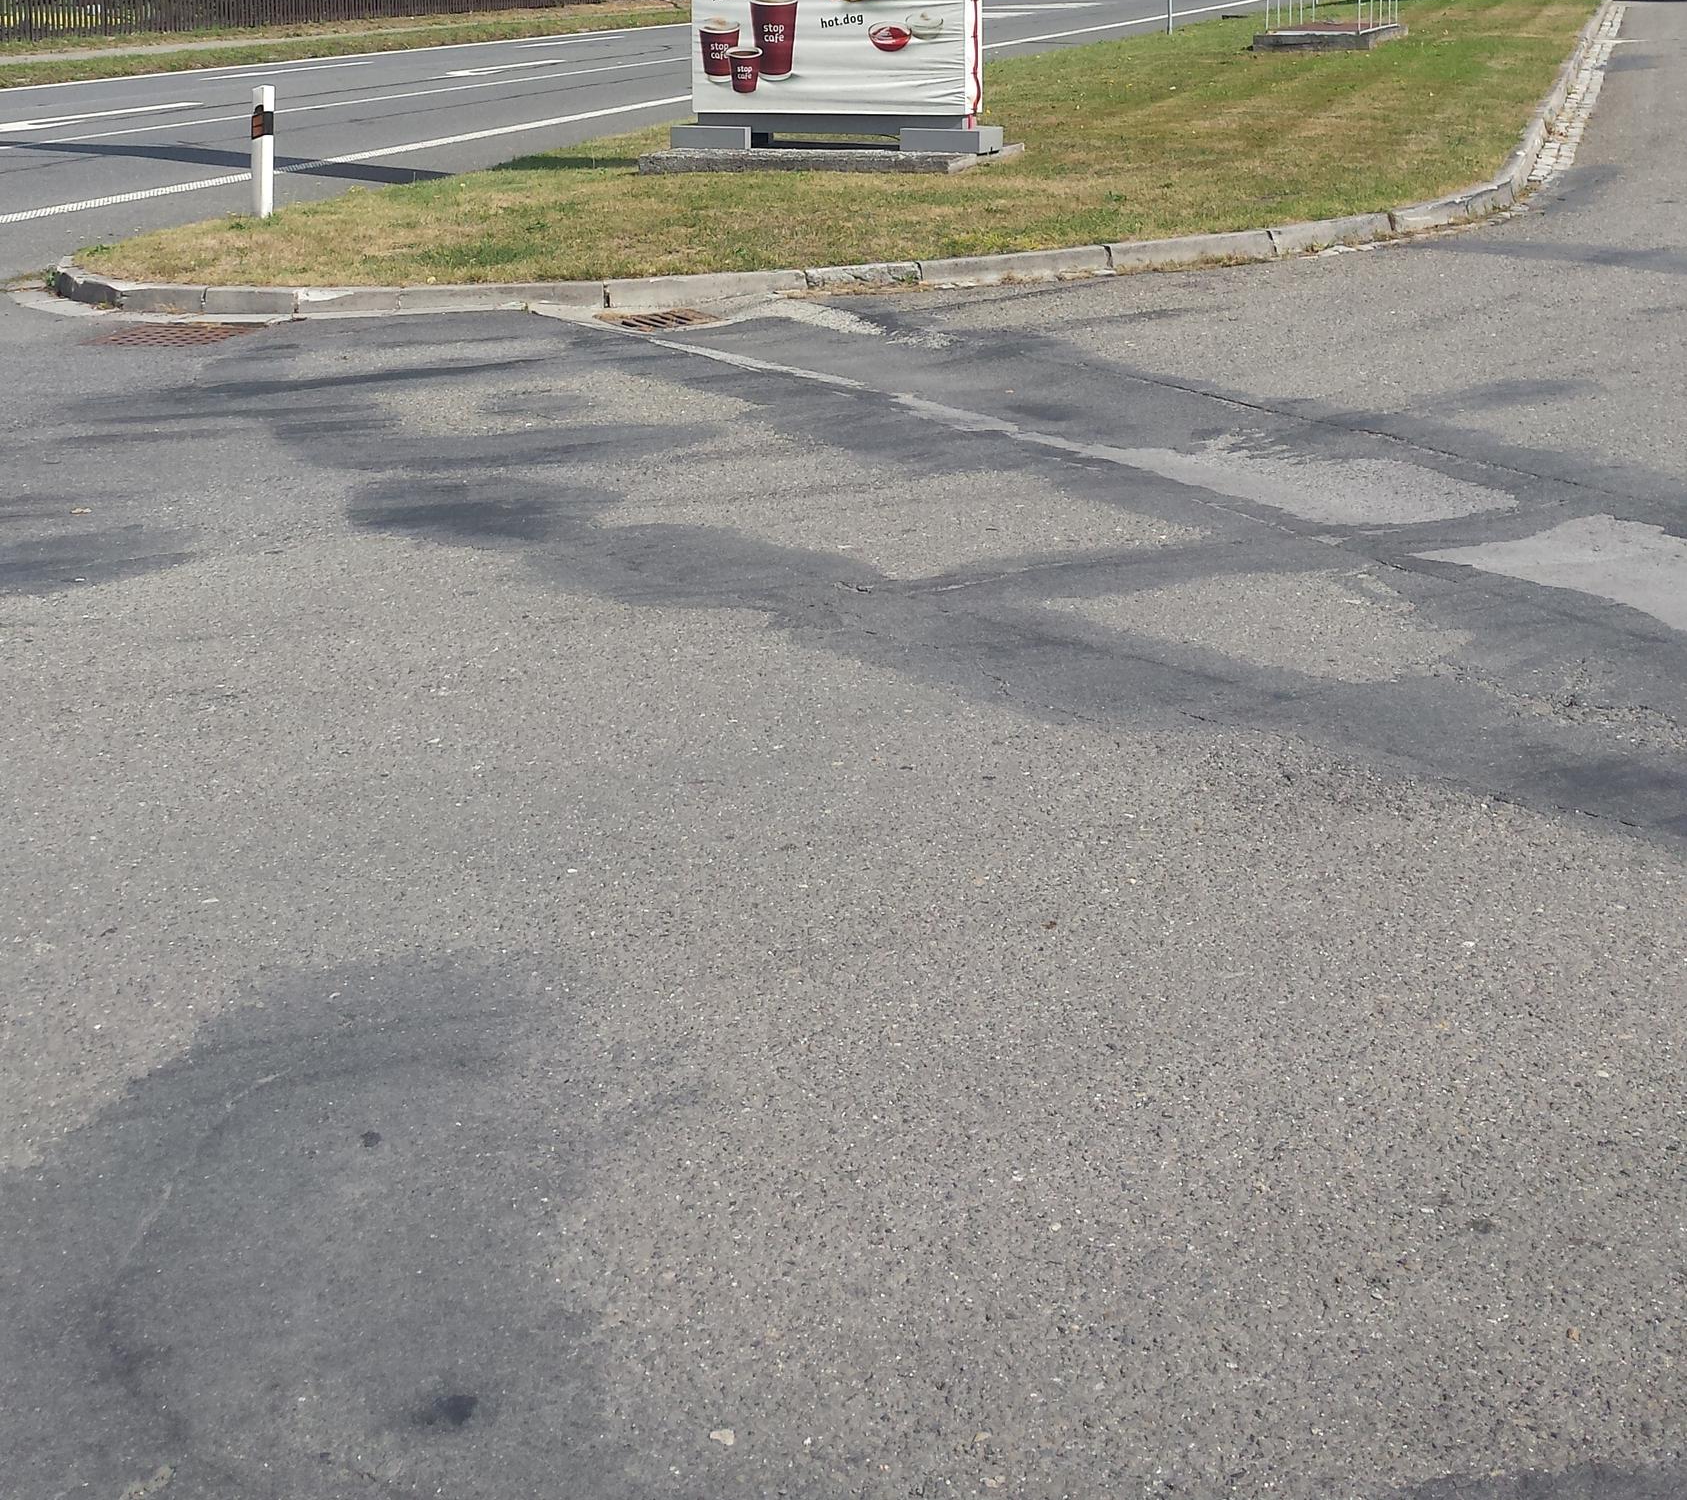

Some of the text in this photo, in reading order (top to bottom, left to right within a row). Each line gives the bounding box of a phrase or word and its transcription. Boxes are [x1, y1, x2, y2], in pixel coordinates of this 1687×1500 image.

[820, 13, 864, 29] hot.dog
[763, 23, 785, 36] stop
[763, 33, 785, 44] cafe
[710, 42, 729, 52] stop
[737, 64, 753, 75] stop
[737, 72, 752, 81] cafe
